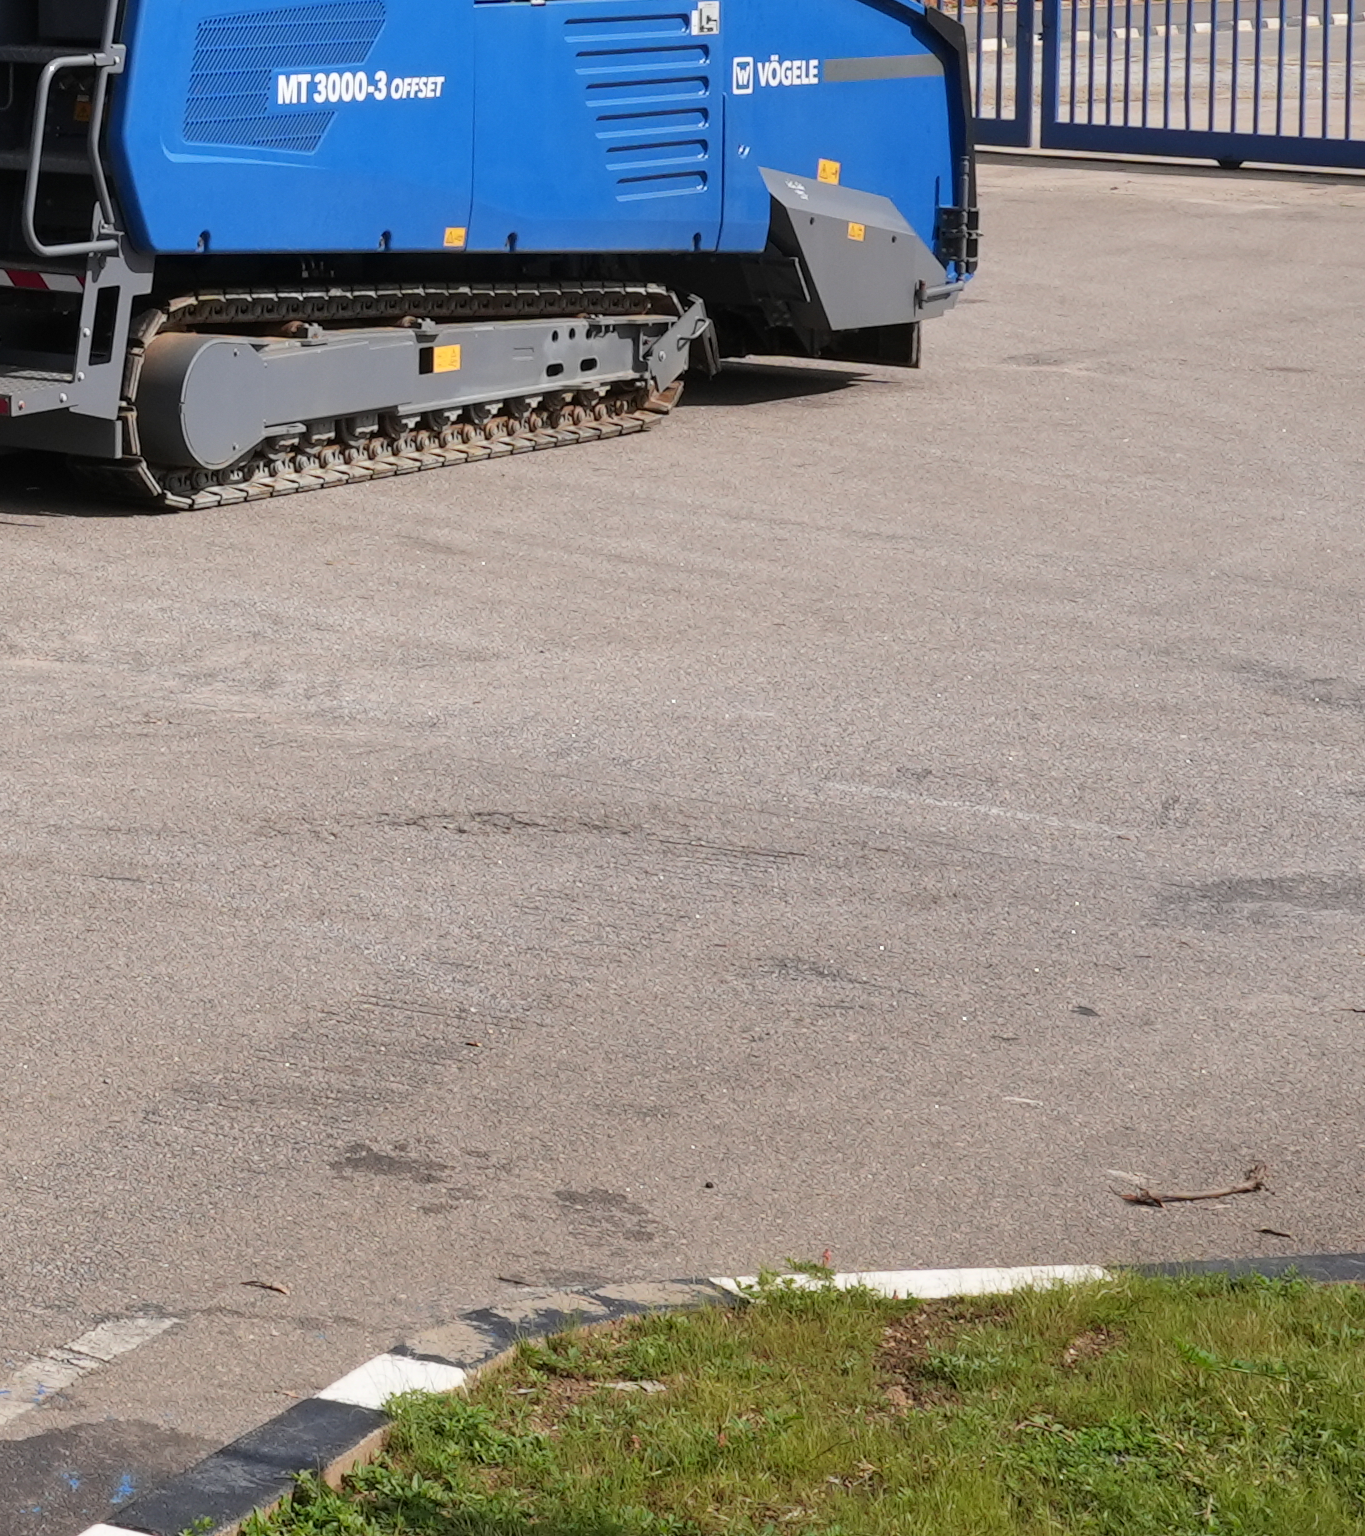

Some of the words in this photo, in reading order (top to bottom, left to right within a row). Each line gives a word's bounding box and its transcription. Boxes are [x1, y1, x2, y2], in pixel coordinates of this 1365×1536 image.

[277, 74, 311, 104] MT
[313, 70, 388, 103] 3000-3
[390, 76, 445, 100] OFFSET
[757, 54, 819, 87] VÖGELE
